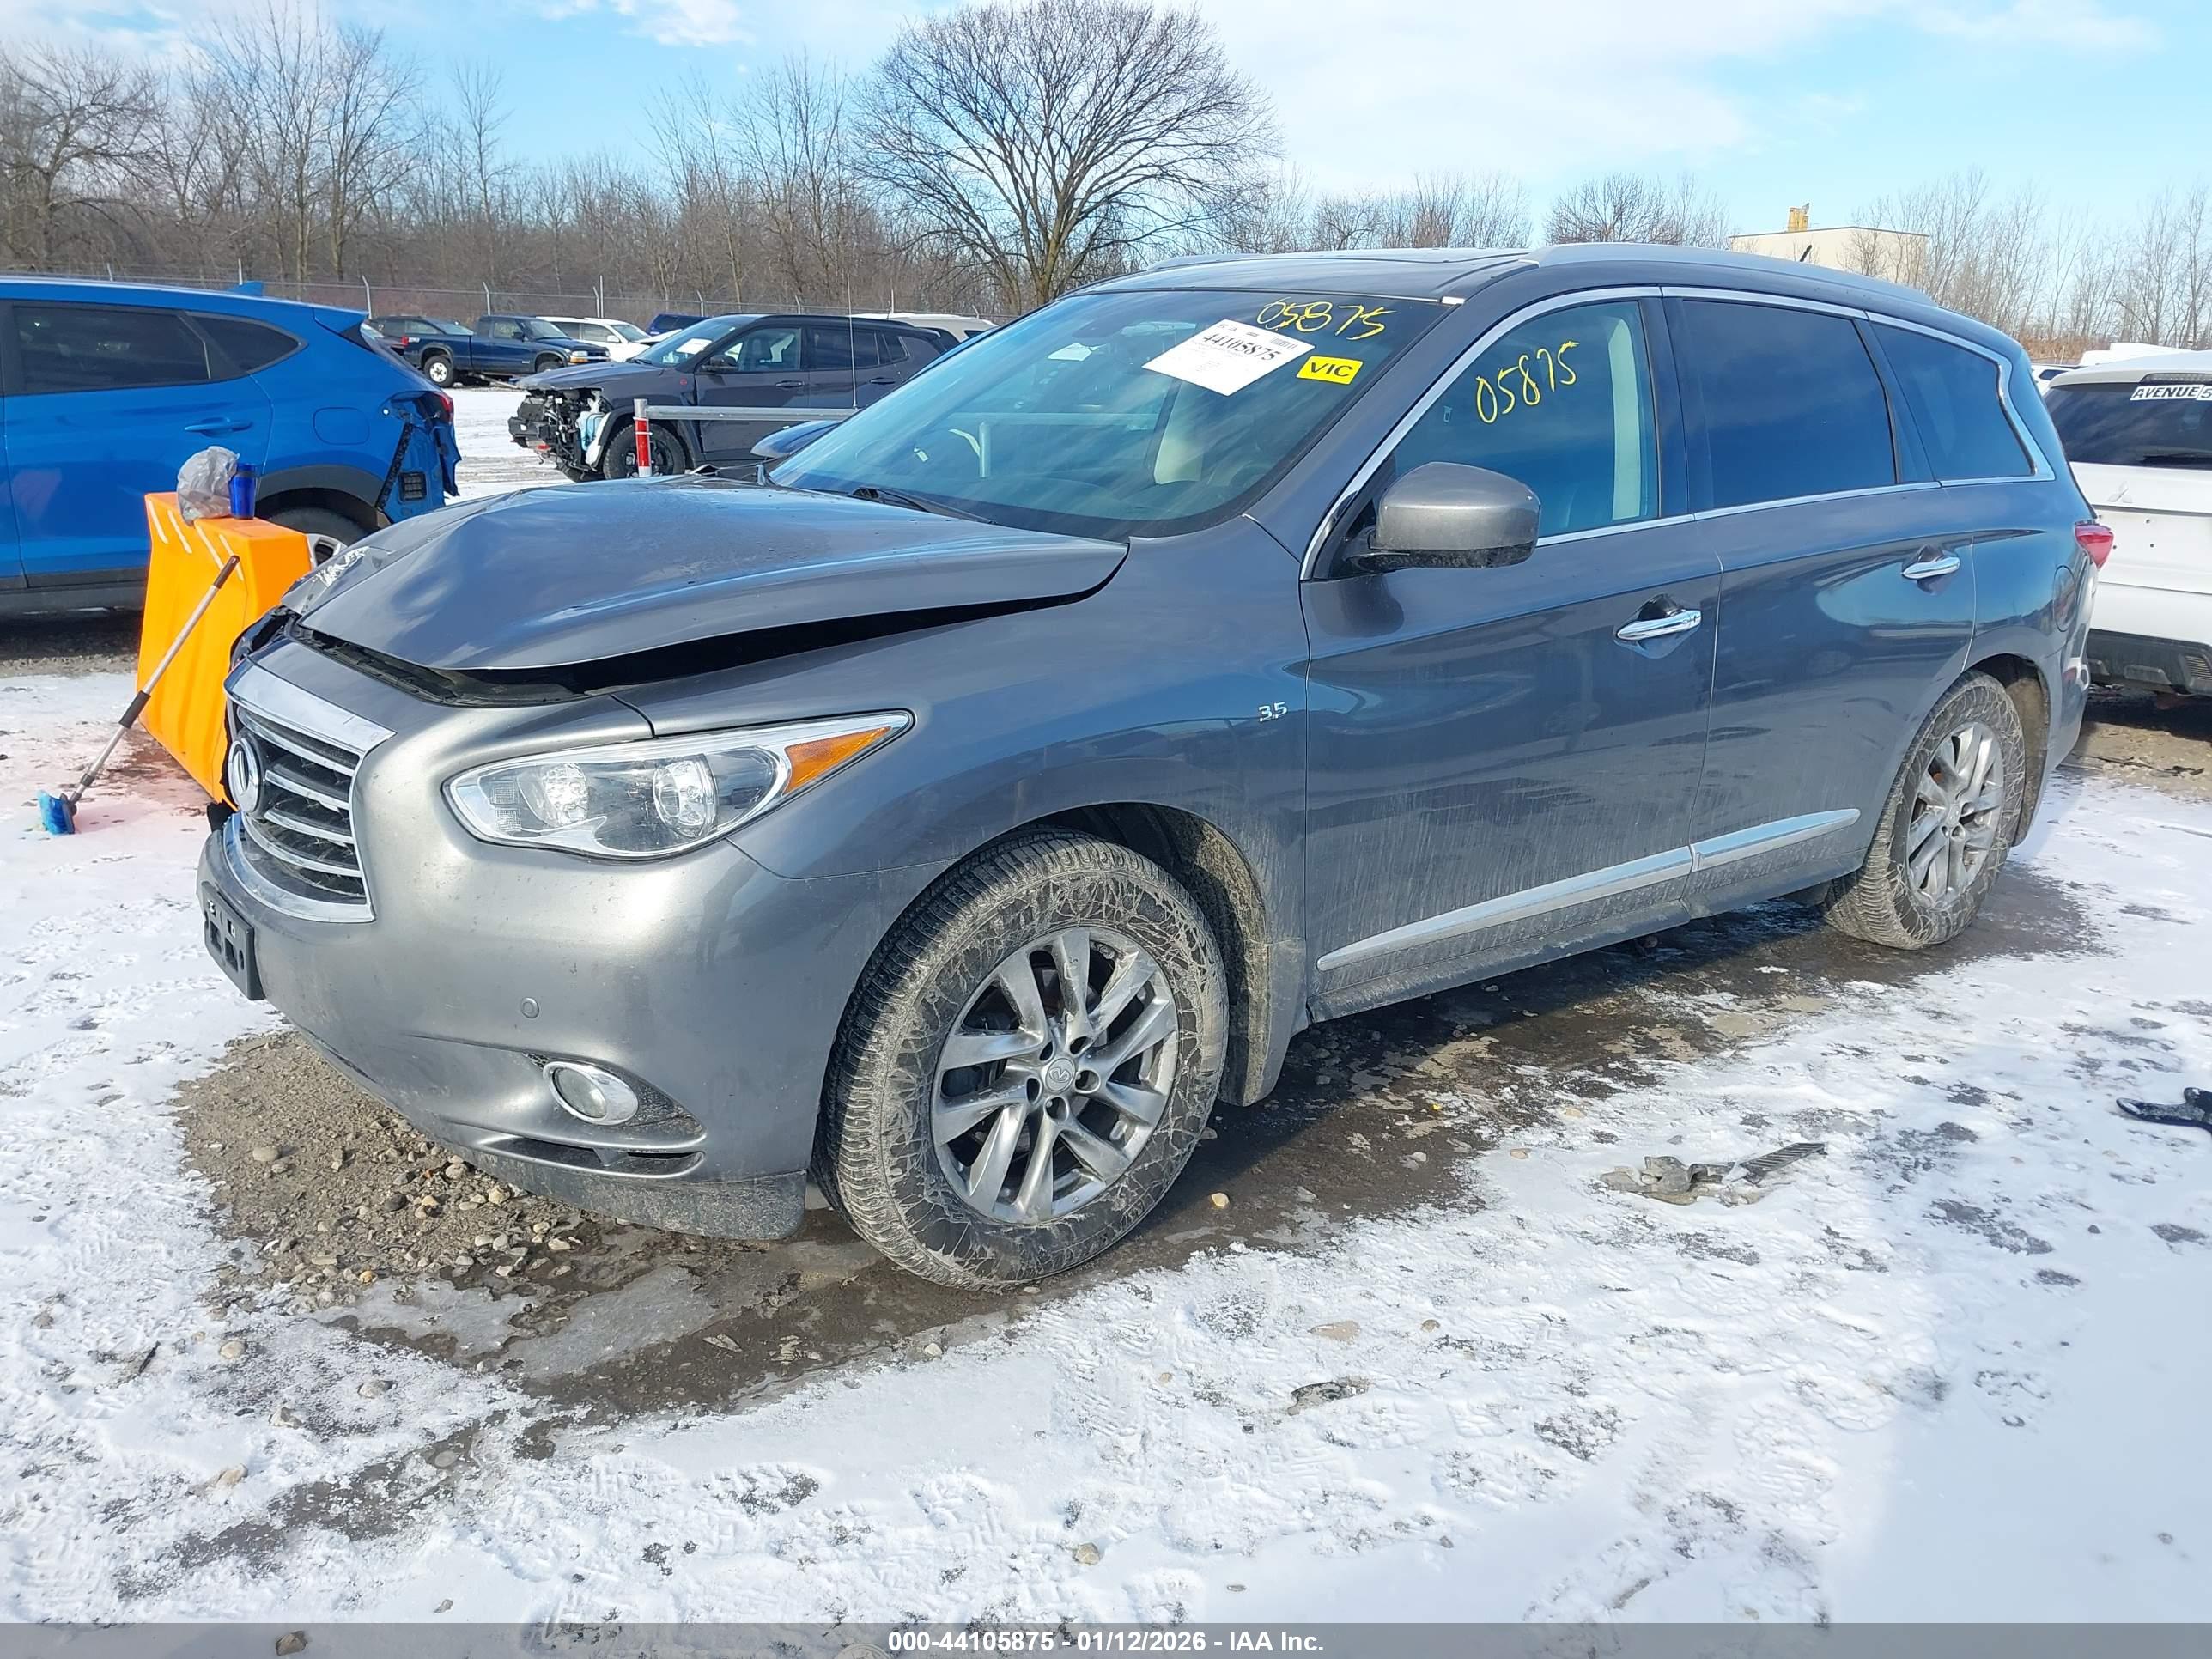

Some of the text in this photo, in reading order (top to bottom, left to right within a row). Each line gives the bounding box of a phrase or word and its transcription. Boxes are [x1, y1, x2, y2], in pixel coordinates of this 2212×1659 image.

[1256, 296, 1397, 341] 05875
[1204, 333, 1282, 361] 44105875
[1310, 361, 1354, 378] VIC
[1475, 340, 1580, 424] 05875
[2132, 386, 2200, 398] AVENUE
